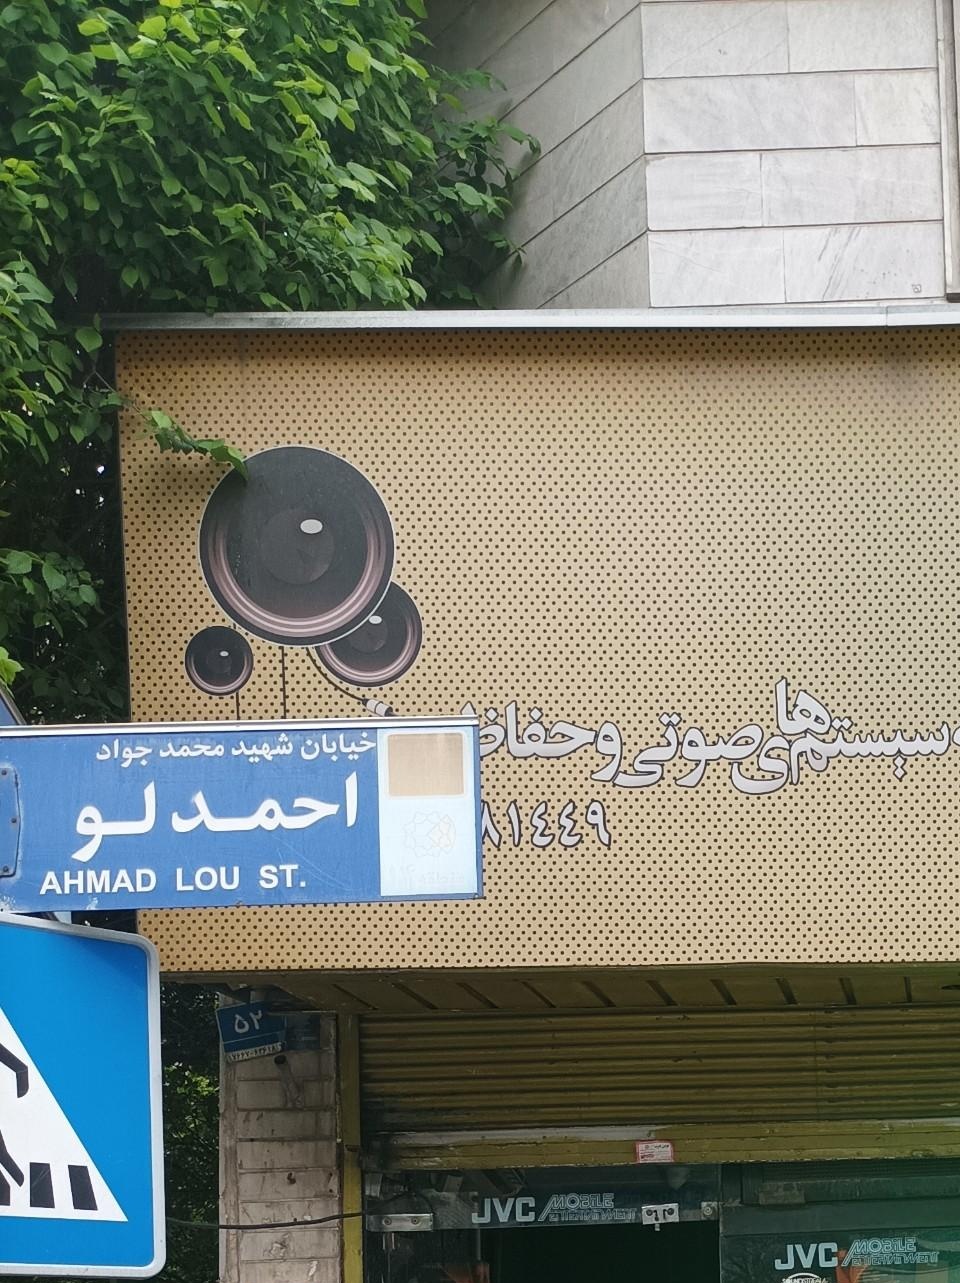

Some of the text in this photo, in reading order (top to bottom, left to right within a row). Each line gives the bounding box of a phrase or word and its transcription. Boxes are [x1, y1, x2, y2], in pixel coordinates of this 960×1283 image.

[96, 731, 377, 768] خیابان شهید محمد جواد
[590, 720, 623, 783] و
[613, 712, 764, 789] صوتی
[71, 771, 359, 863] احمد لو
[39, 864, 307, 895] AHMAD LOU ST.
[234, 1010, 263, 1034] ۵۲
[471, 1193, 615, 1224] JVC MOBILE
[774, 1236, 917, 1271] JVC MOBILE
